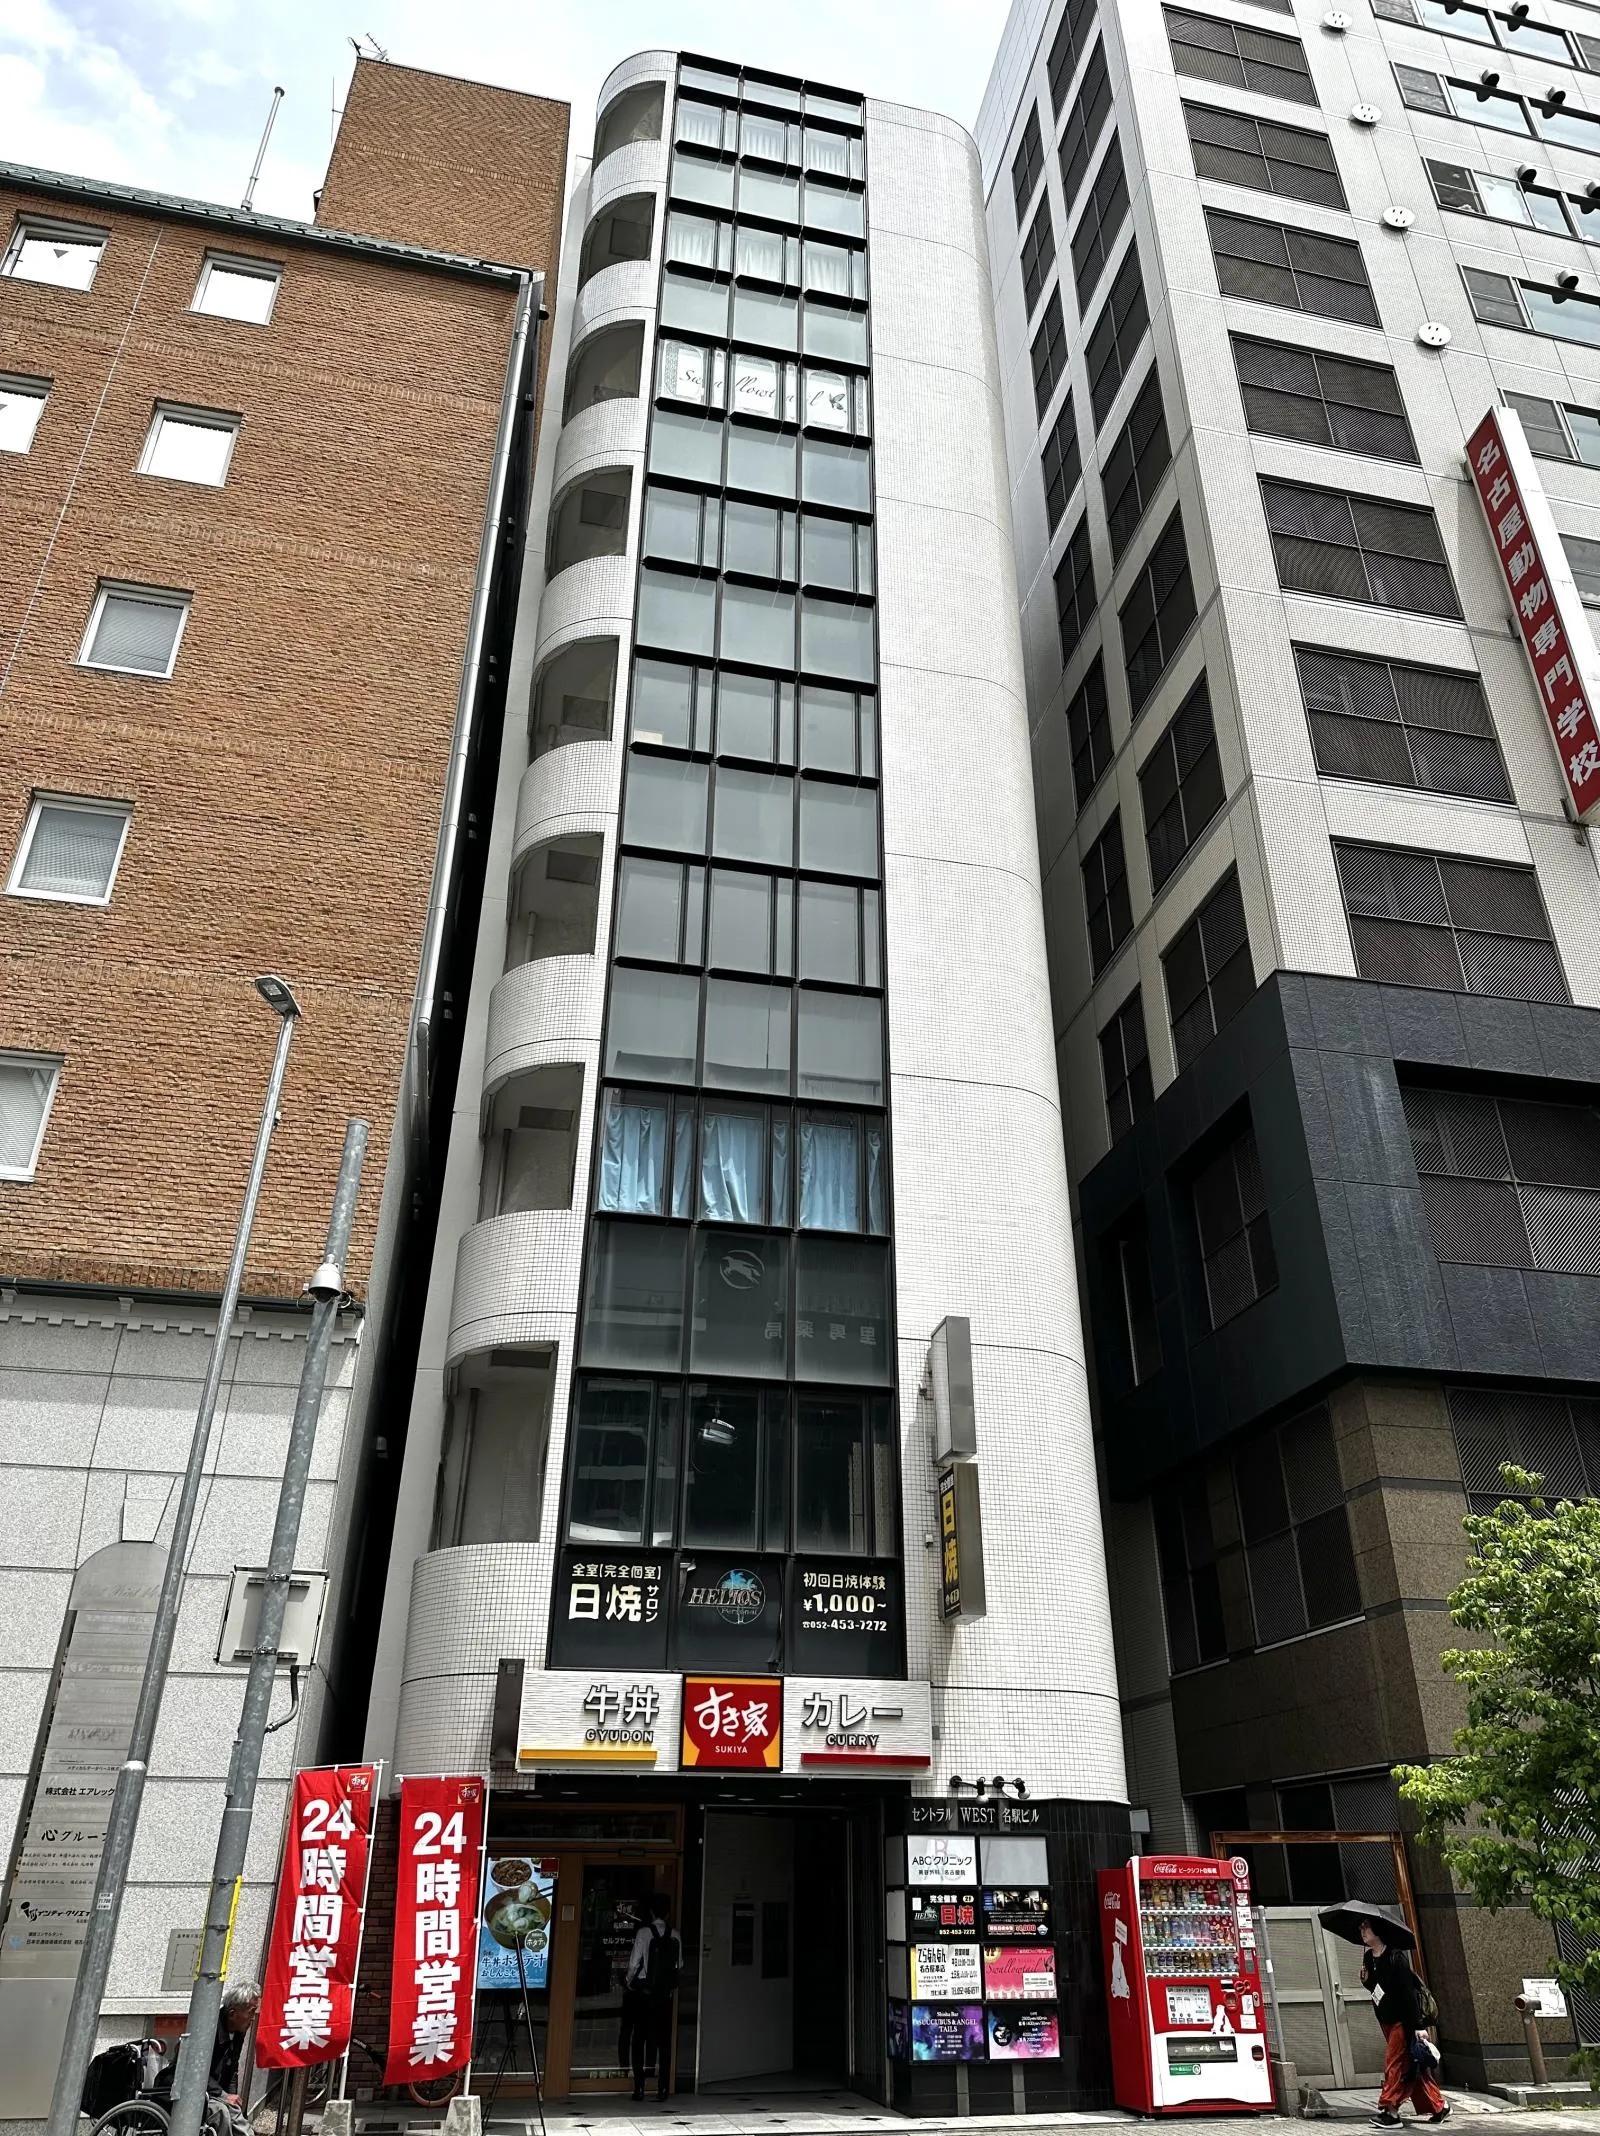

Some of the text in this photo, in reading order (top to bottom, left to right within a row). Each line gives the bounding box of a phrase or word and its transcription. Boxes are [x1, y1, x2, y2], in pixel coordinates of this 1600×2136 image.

[679, 369, 823, 407] Swallowtal
[1476, 438, 1600, 787] 名古屋動物専門学校
[942, 1488, 959, 1584] 日焼
[803, 1571, 886, 1590] 初回日焼体験
[568, 1583, 659, 1622] 日焼 サロン
[688, 1587, 762, 1606] HELIOS
[584, 1684, 660, 1724] 牛丼
[693, 1686, 770, 1743] すき家
[803, 1692, 904, 1729] カレー
[585, 1729, 654, 1744] GYUDON
[714, 1745, 749, 1754] SUKIYA
[826, 1733, 879, 1747] CURRY
[45, 1787, 77, 1796] 株式会社
[911, 1808, 1040, 1824] セントラル WEST 名駅ビル
[911, 1855, 973, 1866] ABCクリニック
[280, 1799, 357, 2050] 24時間営業
[941, 1904, 975, 1926] 日焼
[408, 1812, 467, 2065] 24時間営業
